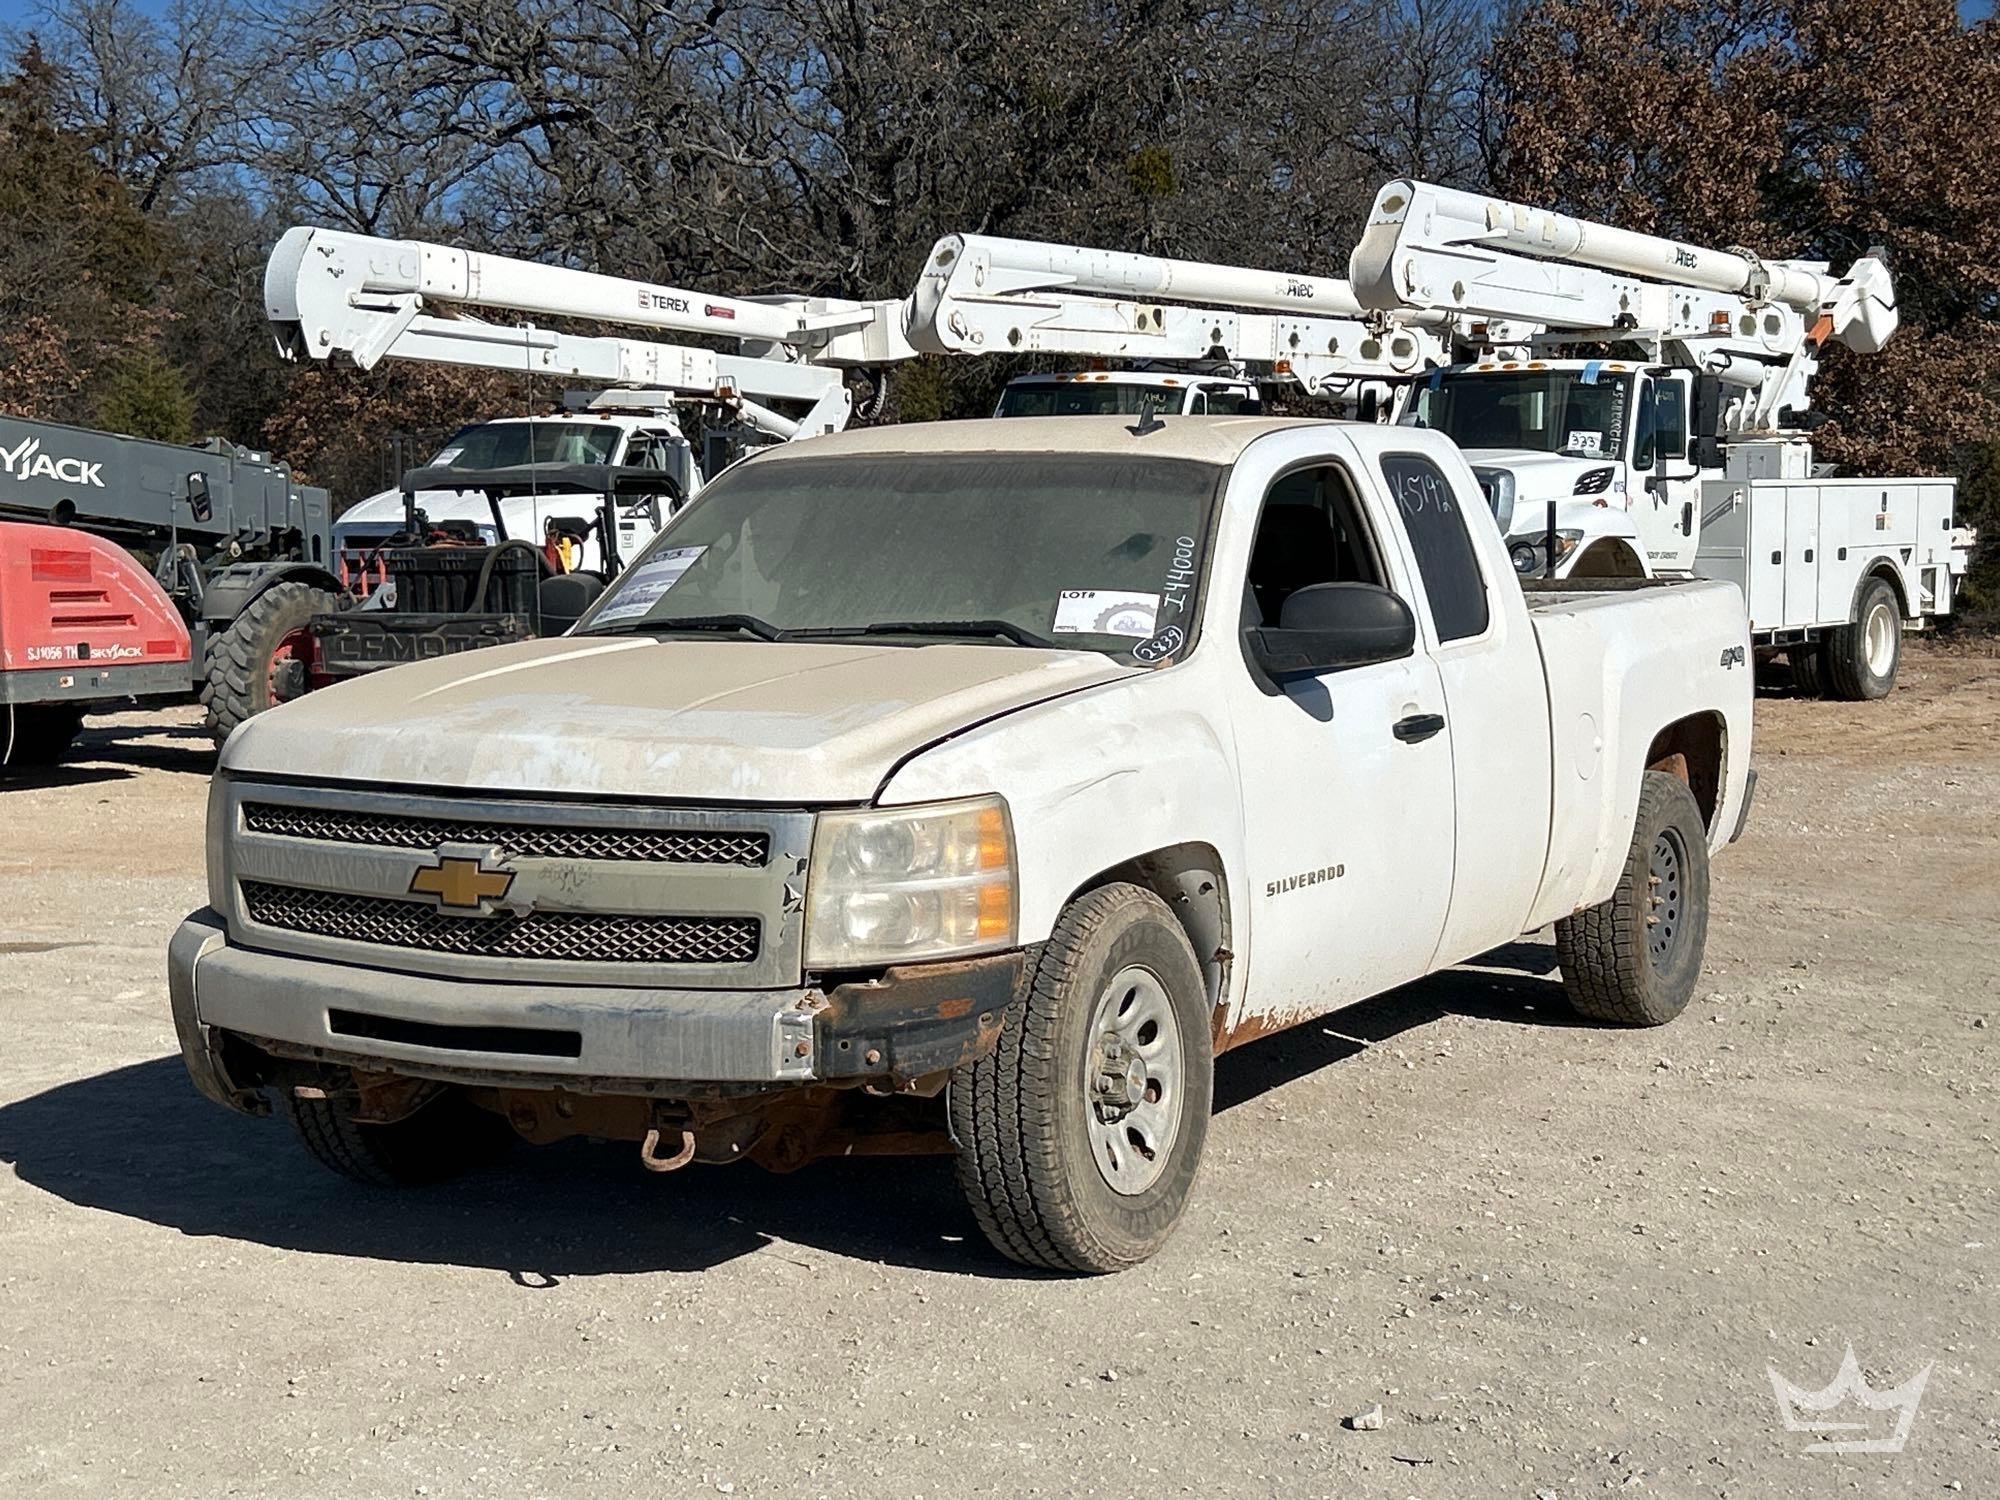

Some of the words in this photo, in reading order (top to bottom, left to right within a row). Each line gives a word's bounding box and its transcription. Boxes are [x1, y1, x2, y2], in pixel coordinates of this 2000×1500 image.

[651, 294, 690, 314] TEREX
[0, 436, 106, 488] YJACK
[90, 643, 144, 660] SKYJACK
[1140, 629, 1181, 660] 2839
[1266, 863, 1345, 898] SILVERADO
